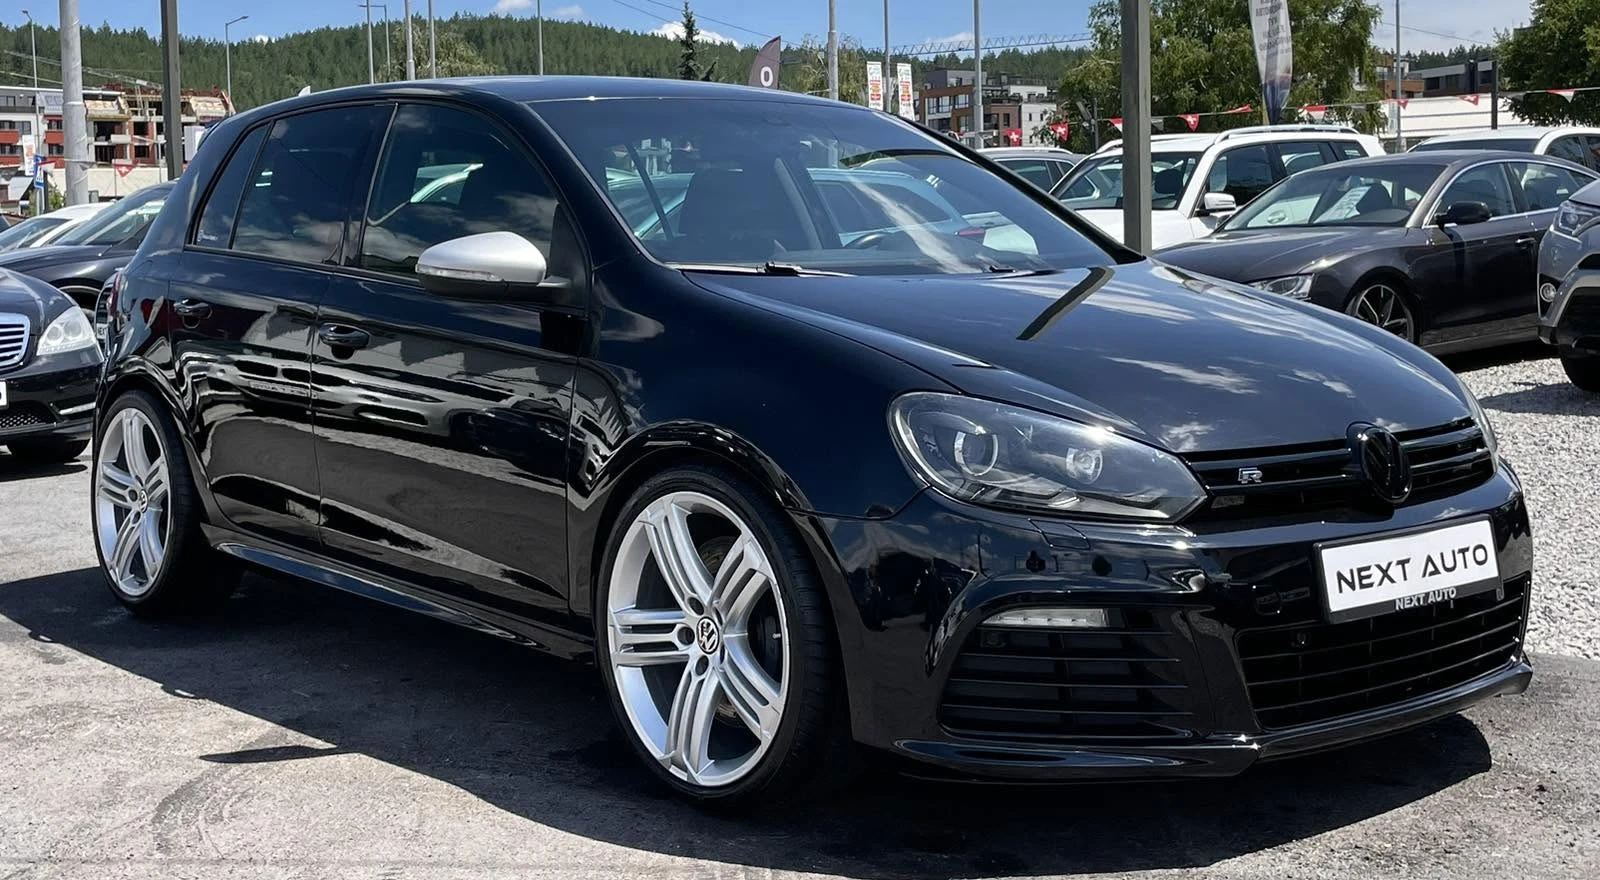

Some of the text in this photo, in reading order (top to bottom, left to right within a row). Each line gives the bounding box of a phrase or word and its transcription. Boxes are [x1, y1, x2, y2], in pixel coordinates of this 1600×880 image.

[1237, 467, 1262, 484] R
[1336, 544, 1488, 594] NEXT AUTO
[1395, 587, 1457, 610] NEXT AUTO
